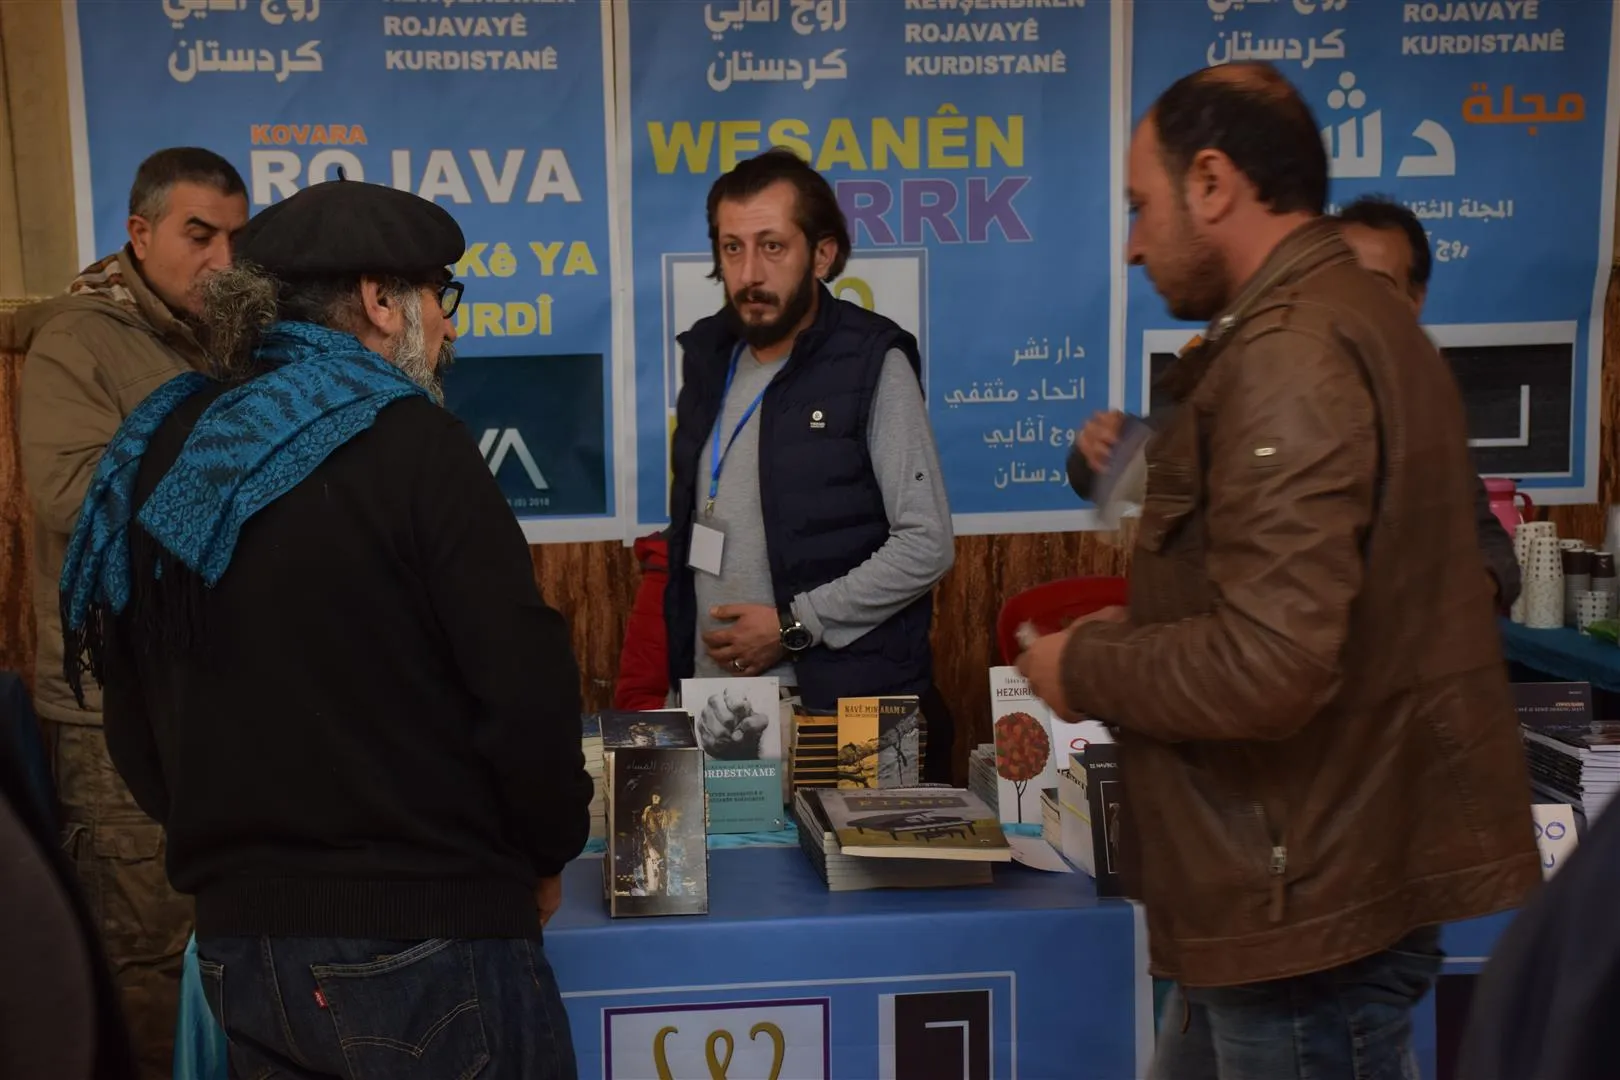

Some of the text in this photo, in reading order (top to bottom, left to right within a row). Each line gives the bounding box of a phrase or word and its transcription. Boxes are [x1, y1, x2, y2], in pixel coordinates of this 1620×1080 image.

[384, 13, 527, 36] ROJAVAYÊ
[905, 18, 1039, 43] ROJAVAYÊ
[1207, 29, 1345, 68] كردستان
[1402, 29, 1565, 54] KURDISTANÊ
[168, 40, 323, 82] كردستان
[386, 46, 558, 70] KURDISTANÊ
[707, 49, 847, 92] كردستان
[905, 49, 1067, 75] KURDISTANÊ
[1462, 82, 1585, 136] مجلة
[251, 125, 367, 145] KOVARA
[1320, 71, 1456, 178] دش
[250, 149, 583, 205] ROJAVA
[834, 176, 1033, 246] RRK
[1402, 198, 1514, 223] المجلة الثقا
[455, 241, 598, 278] Kê YA
[1435, 239, 1470, 262] روج
[453, 293, 554, 338] URDÎ
[1012, 336, 1086, 366] دار نشر
[944, 377, 1085, 409] اتحاد مثقفي
[1050, 426, 1077, 447] وج
[994, 461, 1070, 489] ردستان
[996, 687, 1033, 697] HEZKIRI
